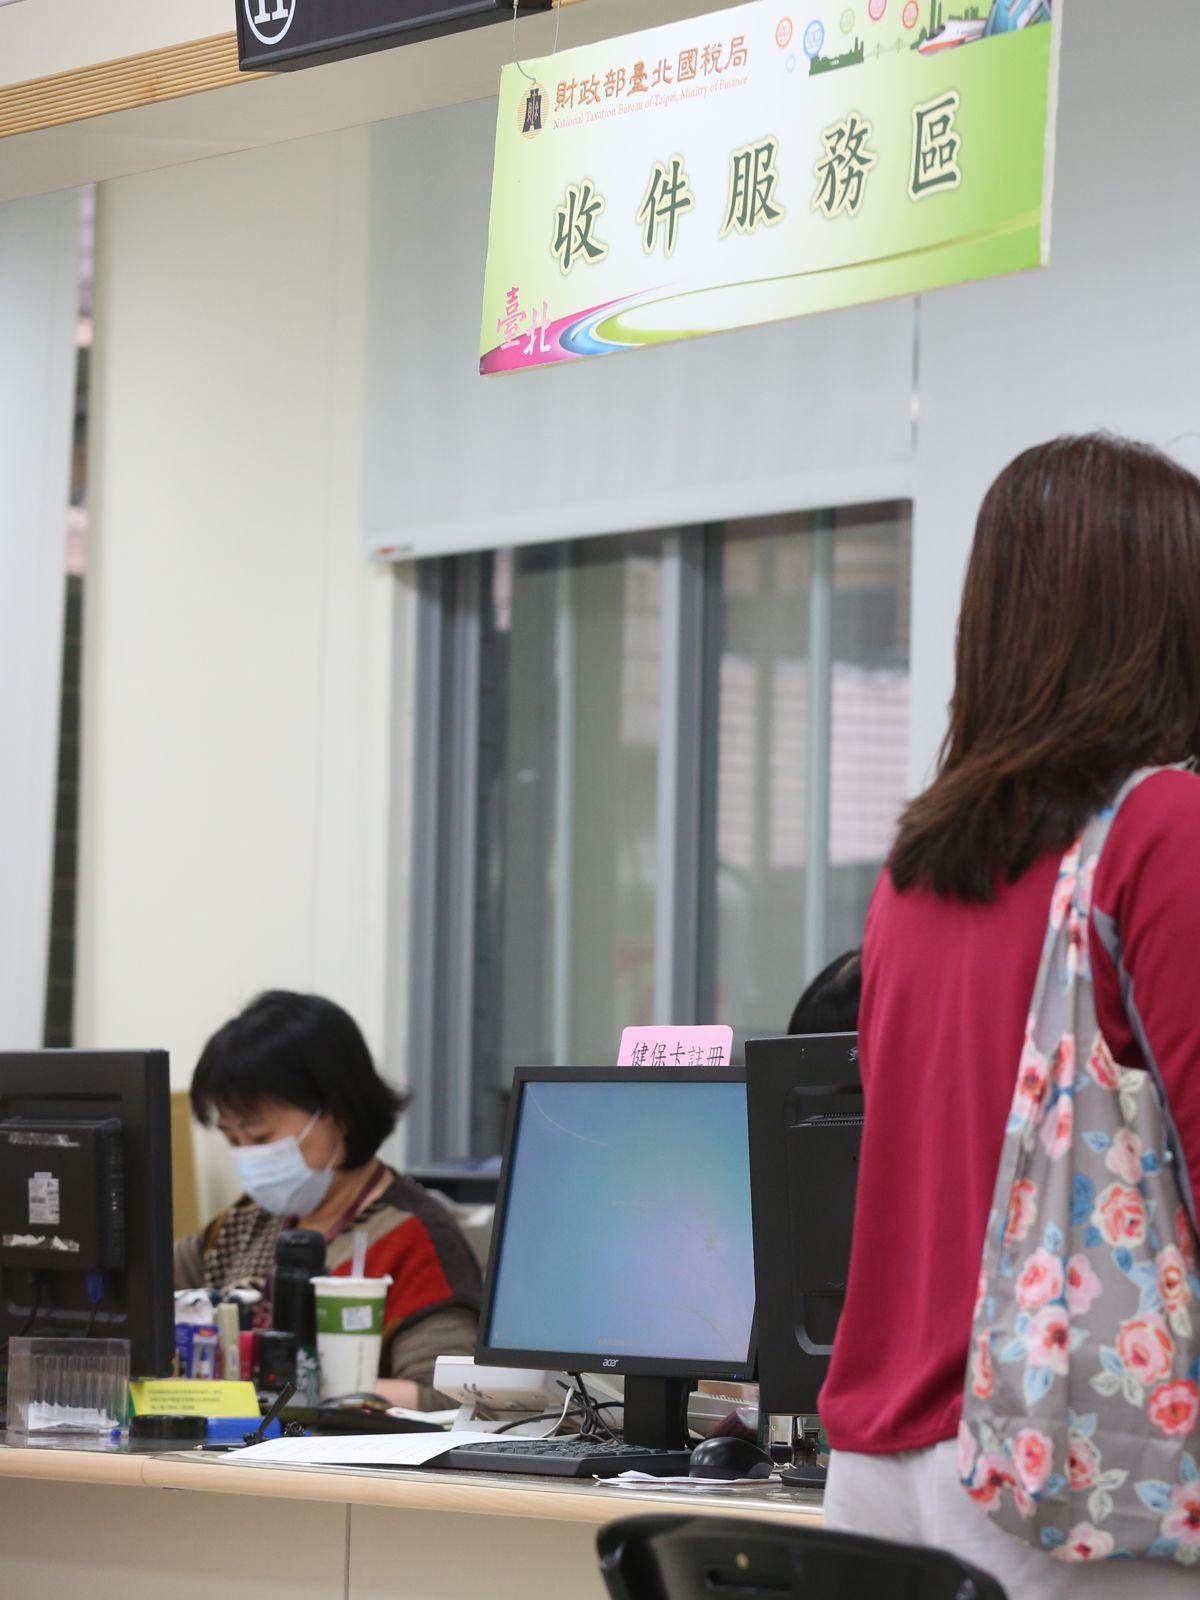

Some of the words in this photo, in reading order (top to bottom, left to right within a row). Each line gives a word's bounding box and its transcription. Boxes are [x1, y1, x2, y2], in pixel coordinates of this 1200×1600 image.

[553, 112, 583, 130] National
[586, 107, 616, 123] Taxation
[618, 103, 643, 116] Bureau
[644, 98, 653, 109] of
[710, 81, 719, 93] of
[719, 75, 748, 91] Finance
[554, 35, 748, 112] 財政部臺北國稅局
[552, 95, 959, 271] 收件服務區
[496, 286, 552, 356] 臺北
[602, 1358, 619, 1367] acer
